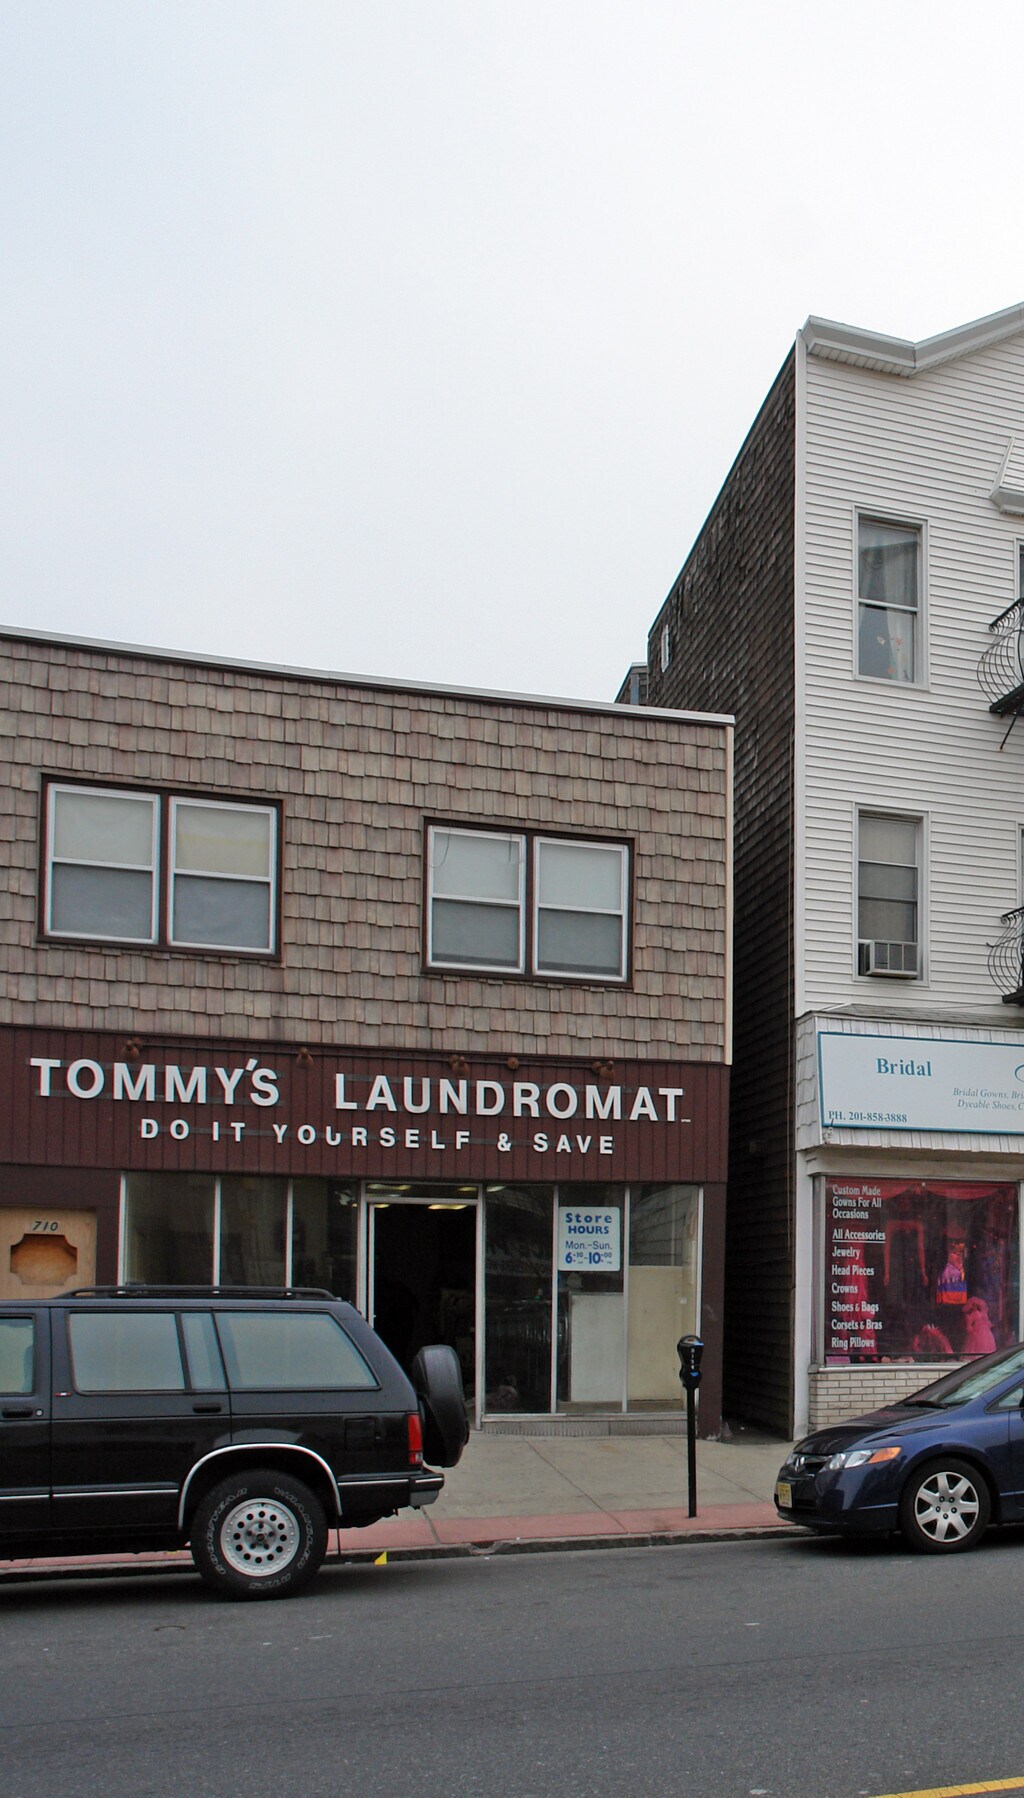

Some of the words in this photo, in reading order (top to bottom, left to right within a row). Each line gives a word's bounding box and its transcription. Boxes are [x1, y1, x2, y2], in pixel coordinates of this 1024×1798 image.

[876, 1058, 932, 1077] Bridal
[30, 1057, 280, 1107] TOMMY'S
[335, 1073, 684, 1123] LAUNDROMAT
[953, 1088, 978, 1097] Bridal
[980, 1089, 1009, 1100] Gowns,
[957, 1099, 990, 1110] Dyeable
[828, 1110, 846, 1121] PH.
[848, 1111, 908, 1123] 201-858-3888
[140, 1118, 190, 1140] DO
[212, 1121, 246, 1142] IT
[272, 1123, 470, 1150] YOURSELF
[497, 1133, 511, 1152] &
[533, 1133, 614, 1155] SAVE
[832, 1184, 860, 1195] Custom
[862, 1185, 881, 1196] Made
[832, 1196, 857, 1207] Gowns
[858, 1197, 870, 1207] For
[871, 1197, 882, 1208] All
[565, 1212, 612, 1223] Store
[832, 1208, 869, 1219] Occasions
[32, 1221, 59, 1232] 710
[568, 1225, 609, 1234] HOURS
[832, 1228, 843, 1239] All
[844, 1229, 886, 1240] Accessories
[832, 1246, 860, 1259] Jewelry
[831, 1264, 850, 1276] Head
[852, 1264, 875, 1276] Pieces
[831, 1282, 858, 1294] Crowns
[831, 1301, 854, 1312] Shoes
[855, 1302, 860, 1312] &
[861, 1301, 879, 1315] Bags
[831, 1319, 859, 1330] Corsets
[860, 1321, 865, 1330] &
[866, 1319, 883, 1330] Bras
[831, 1337, 848, 1350] Ring
[849, 1337, 875, 1348] Pillows
